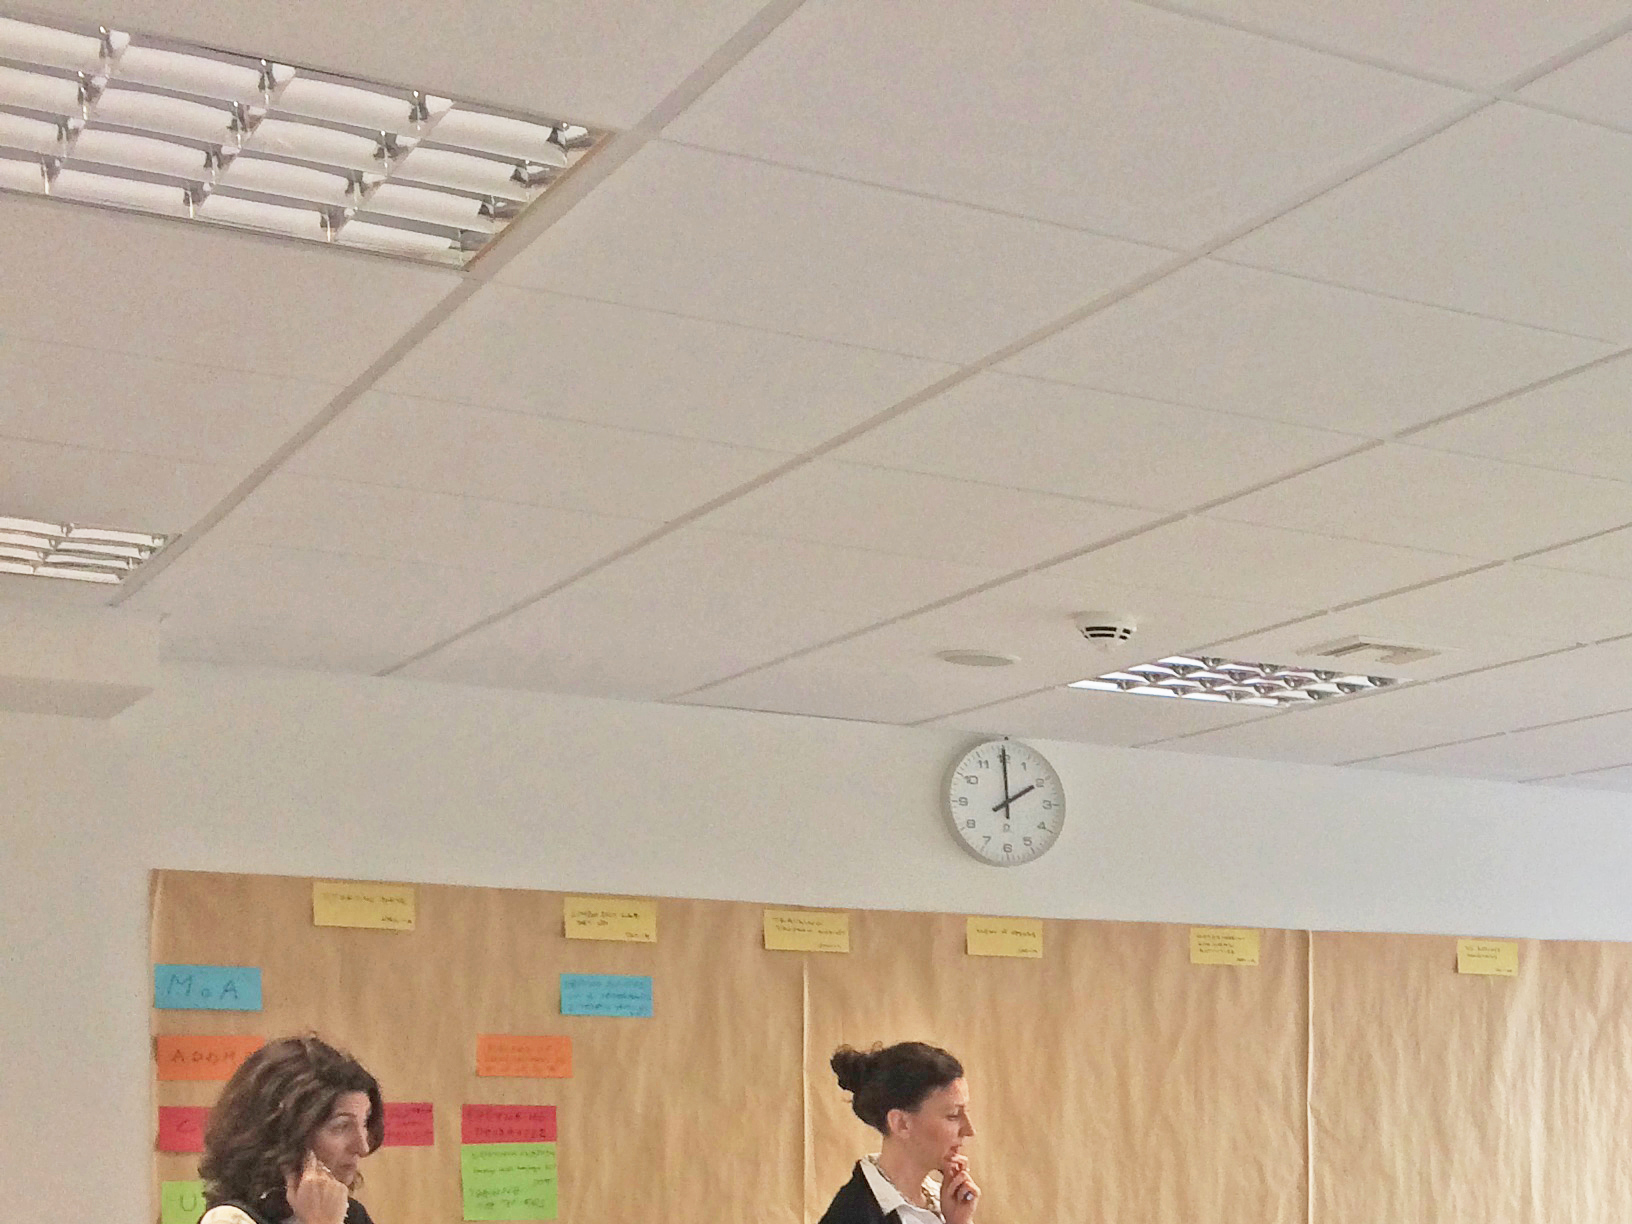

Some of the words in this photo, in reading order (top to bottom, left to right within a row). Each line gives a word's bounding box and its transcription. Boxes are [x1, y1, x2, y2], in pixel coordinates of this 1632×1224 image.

[978, 759, 989, 769] 11
[1021, 762, 1027, 771] 1
[964, 775, 979, 785] 10
[1035, 777, 1045, 788] 2
[958, 796, 968, 806] 9
[1042, 799, 1052, 809] 3
[966, 819, 976, 828] 8
[1037, 821, 1046, 831] 4
[982, 835, 991, 846] 7
[1023, 837, 1032, 846] 5
[1003, 843, 1012, 853] 6
